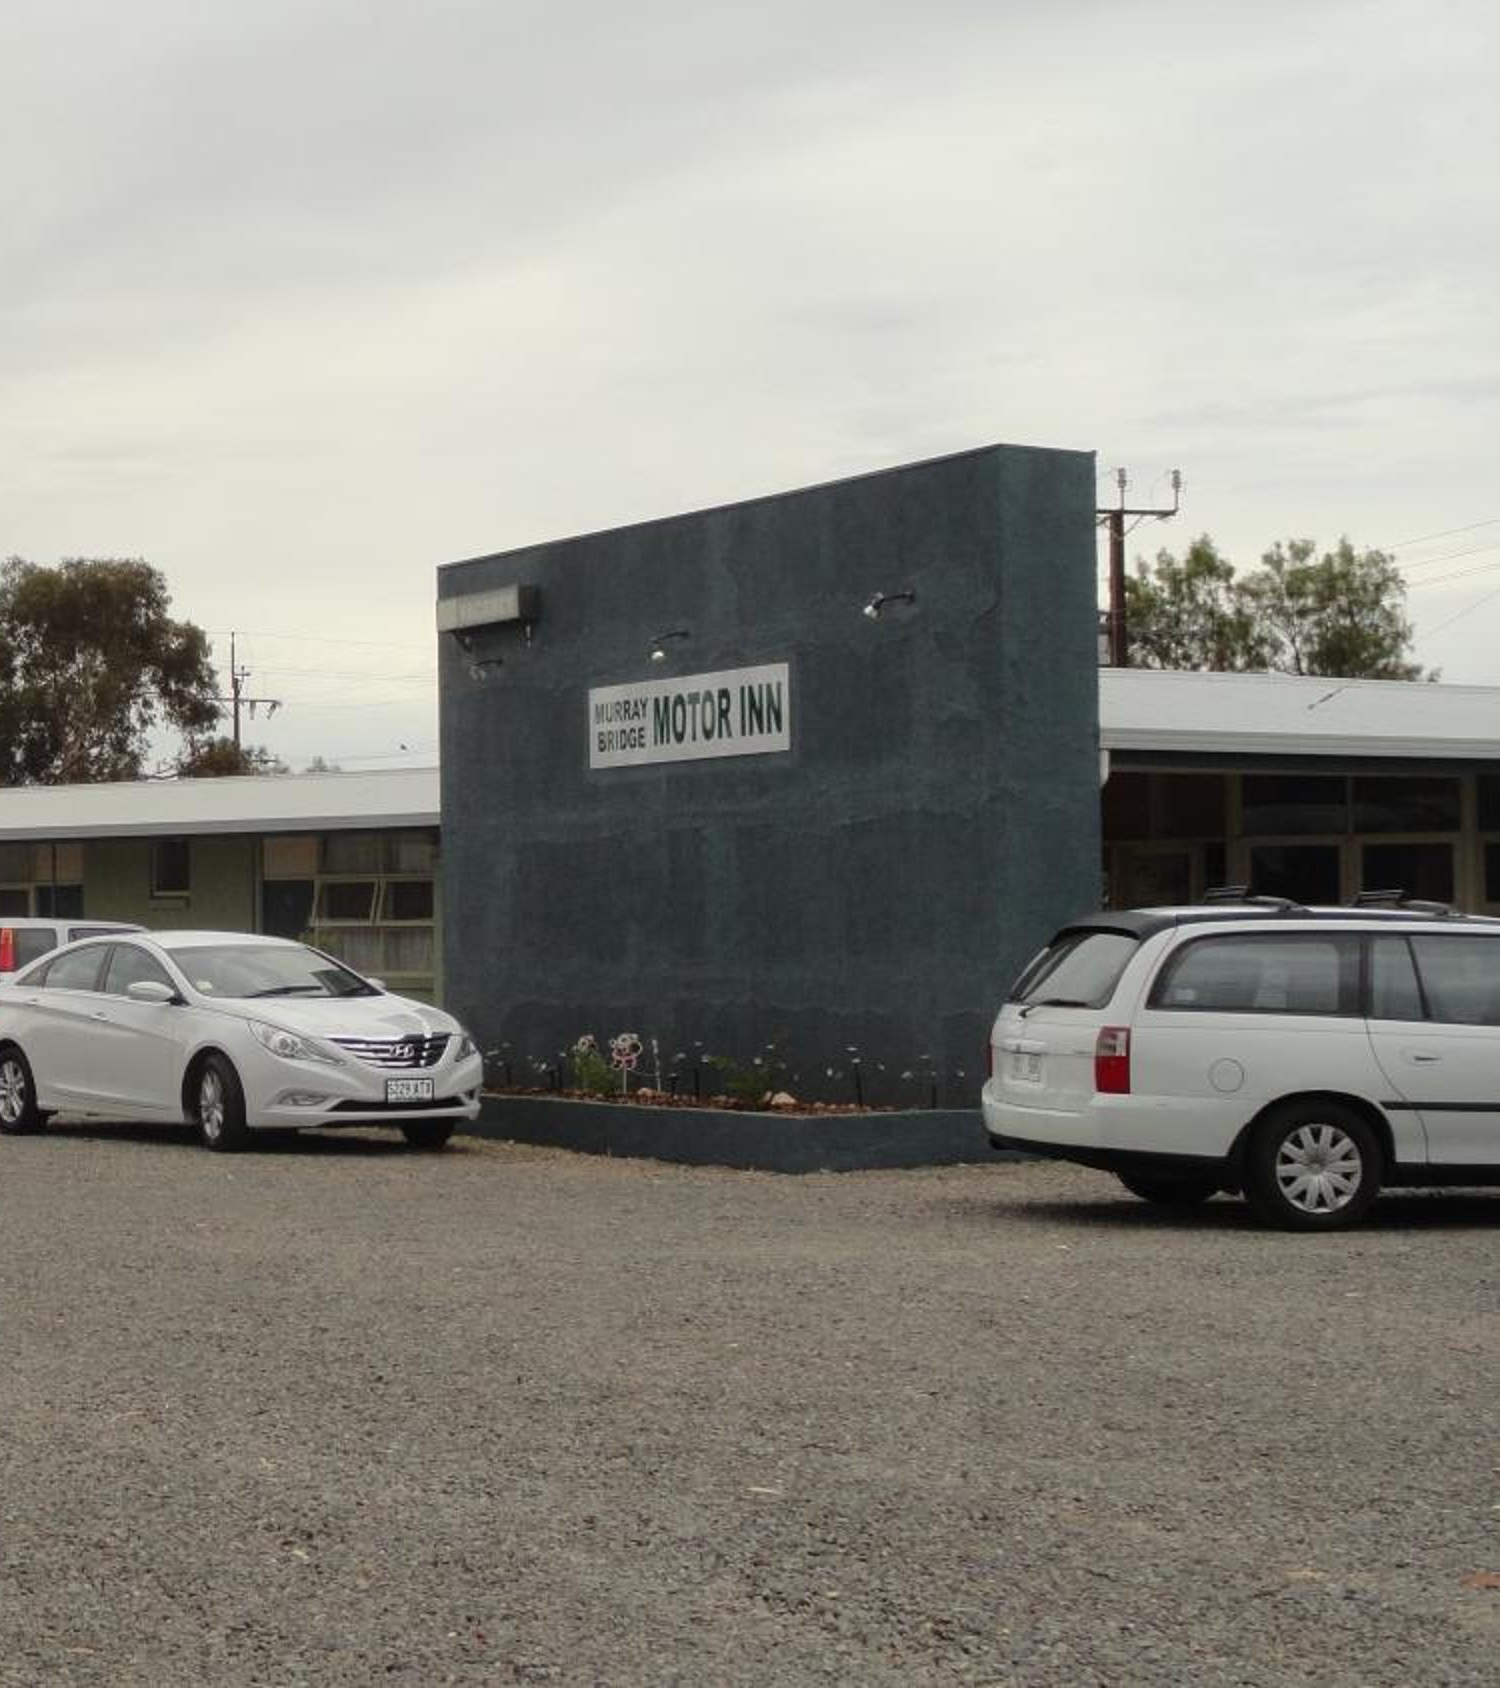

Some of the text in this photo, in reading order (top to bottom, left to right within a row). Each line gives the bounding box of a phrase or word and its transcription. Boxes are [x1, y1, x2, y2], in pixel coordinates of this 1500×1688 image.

[595, 697, 648, 724] MURRAY
[653, 681, 783, 745] MOTOR INN
[597, 727, 645, 752] BRIDGE
